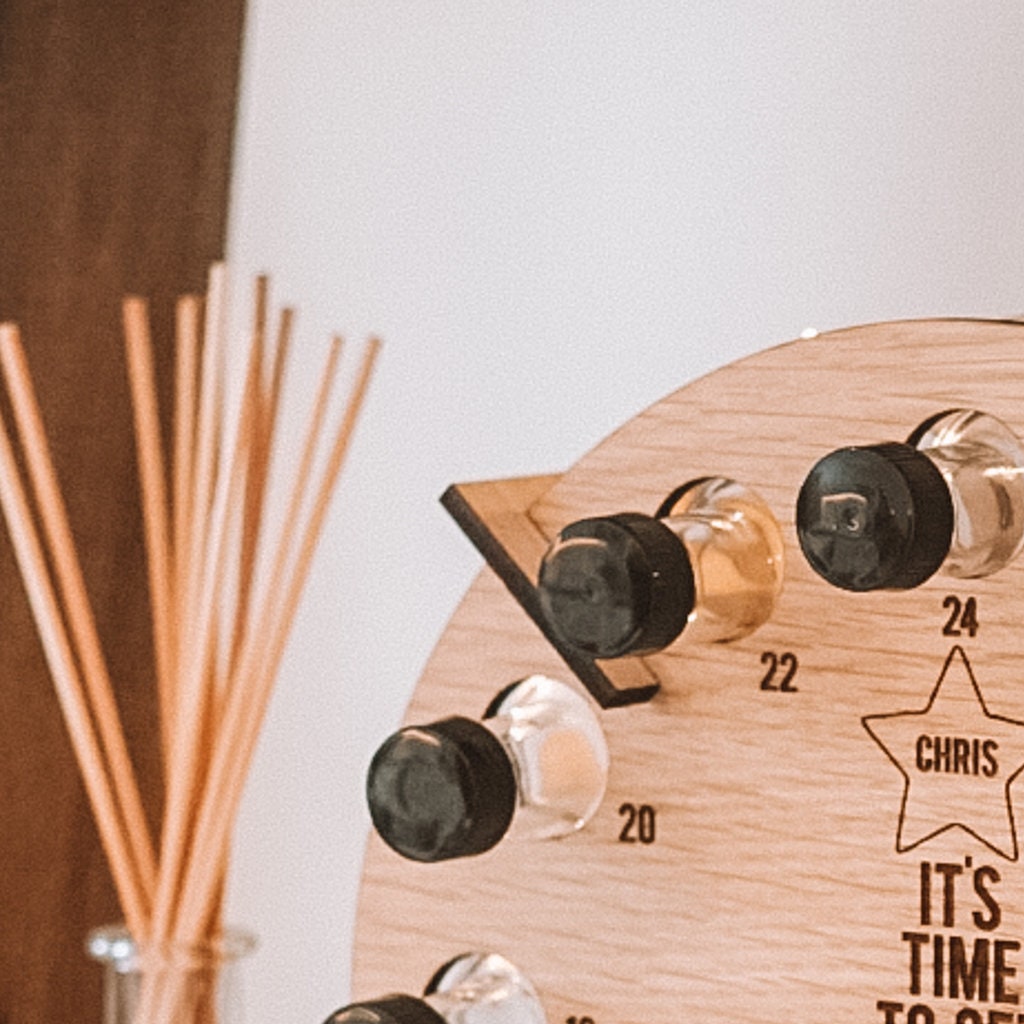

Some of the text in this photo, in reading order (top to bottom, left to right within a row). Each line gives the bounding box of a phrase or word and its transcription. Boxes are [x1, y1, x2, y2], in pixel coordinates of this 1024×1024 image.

[943, 595, 979, 638] 24
[760, 651, 799, 693] 22
[915, 734, 999, 778] CHRIS
[618, 802, 656, 844] 20
[919, 856, 1001, 931] IT'S
[901, 932, 1021, 1004] TIME
